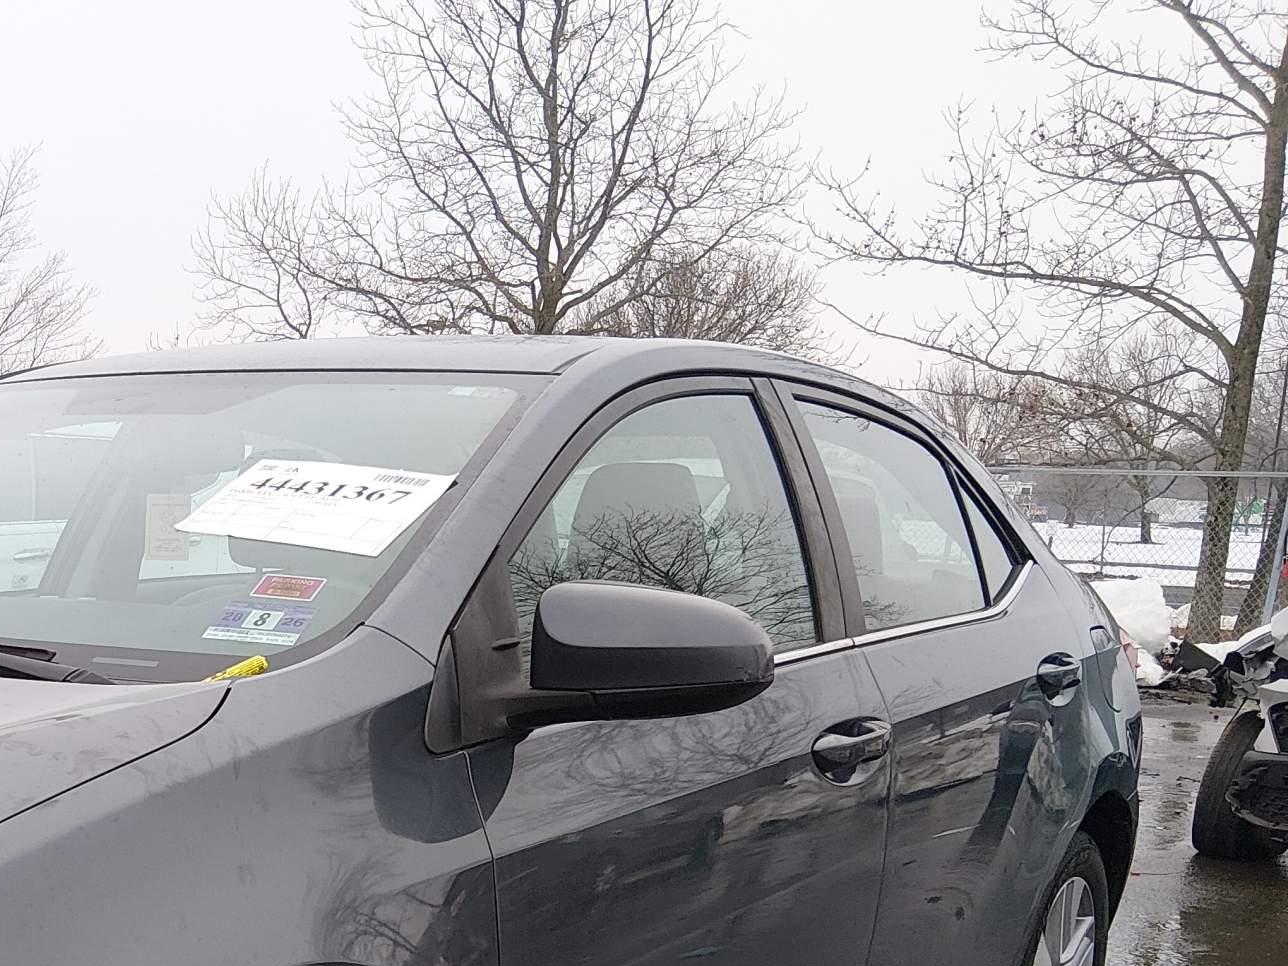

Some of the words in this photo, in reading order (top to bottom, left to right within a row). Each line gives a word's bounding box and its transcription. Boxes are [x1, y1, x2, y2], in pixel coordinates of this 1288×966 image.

[249, 476, 414, 505] 44431367
[222, 611, 244, 622] 20
[253, 612, 271, 627] 8
[281, 616, 307, 627] 26
